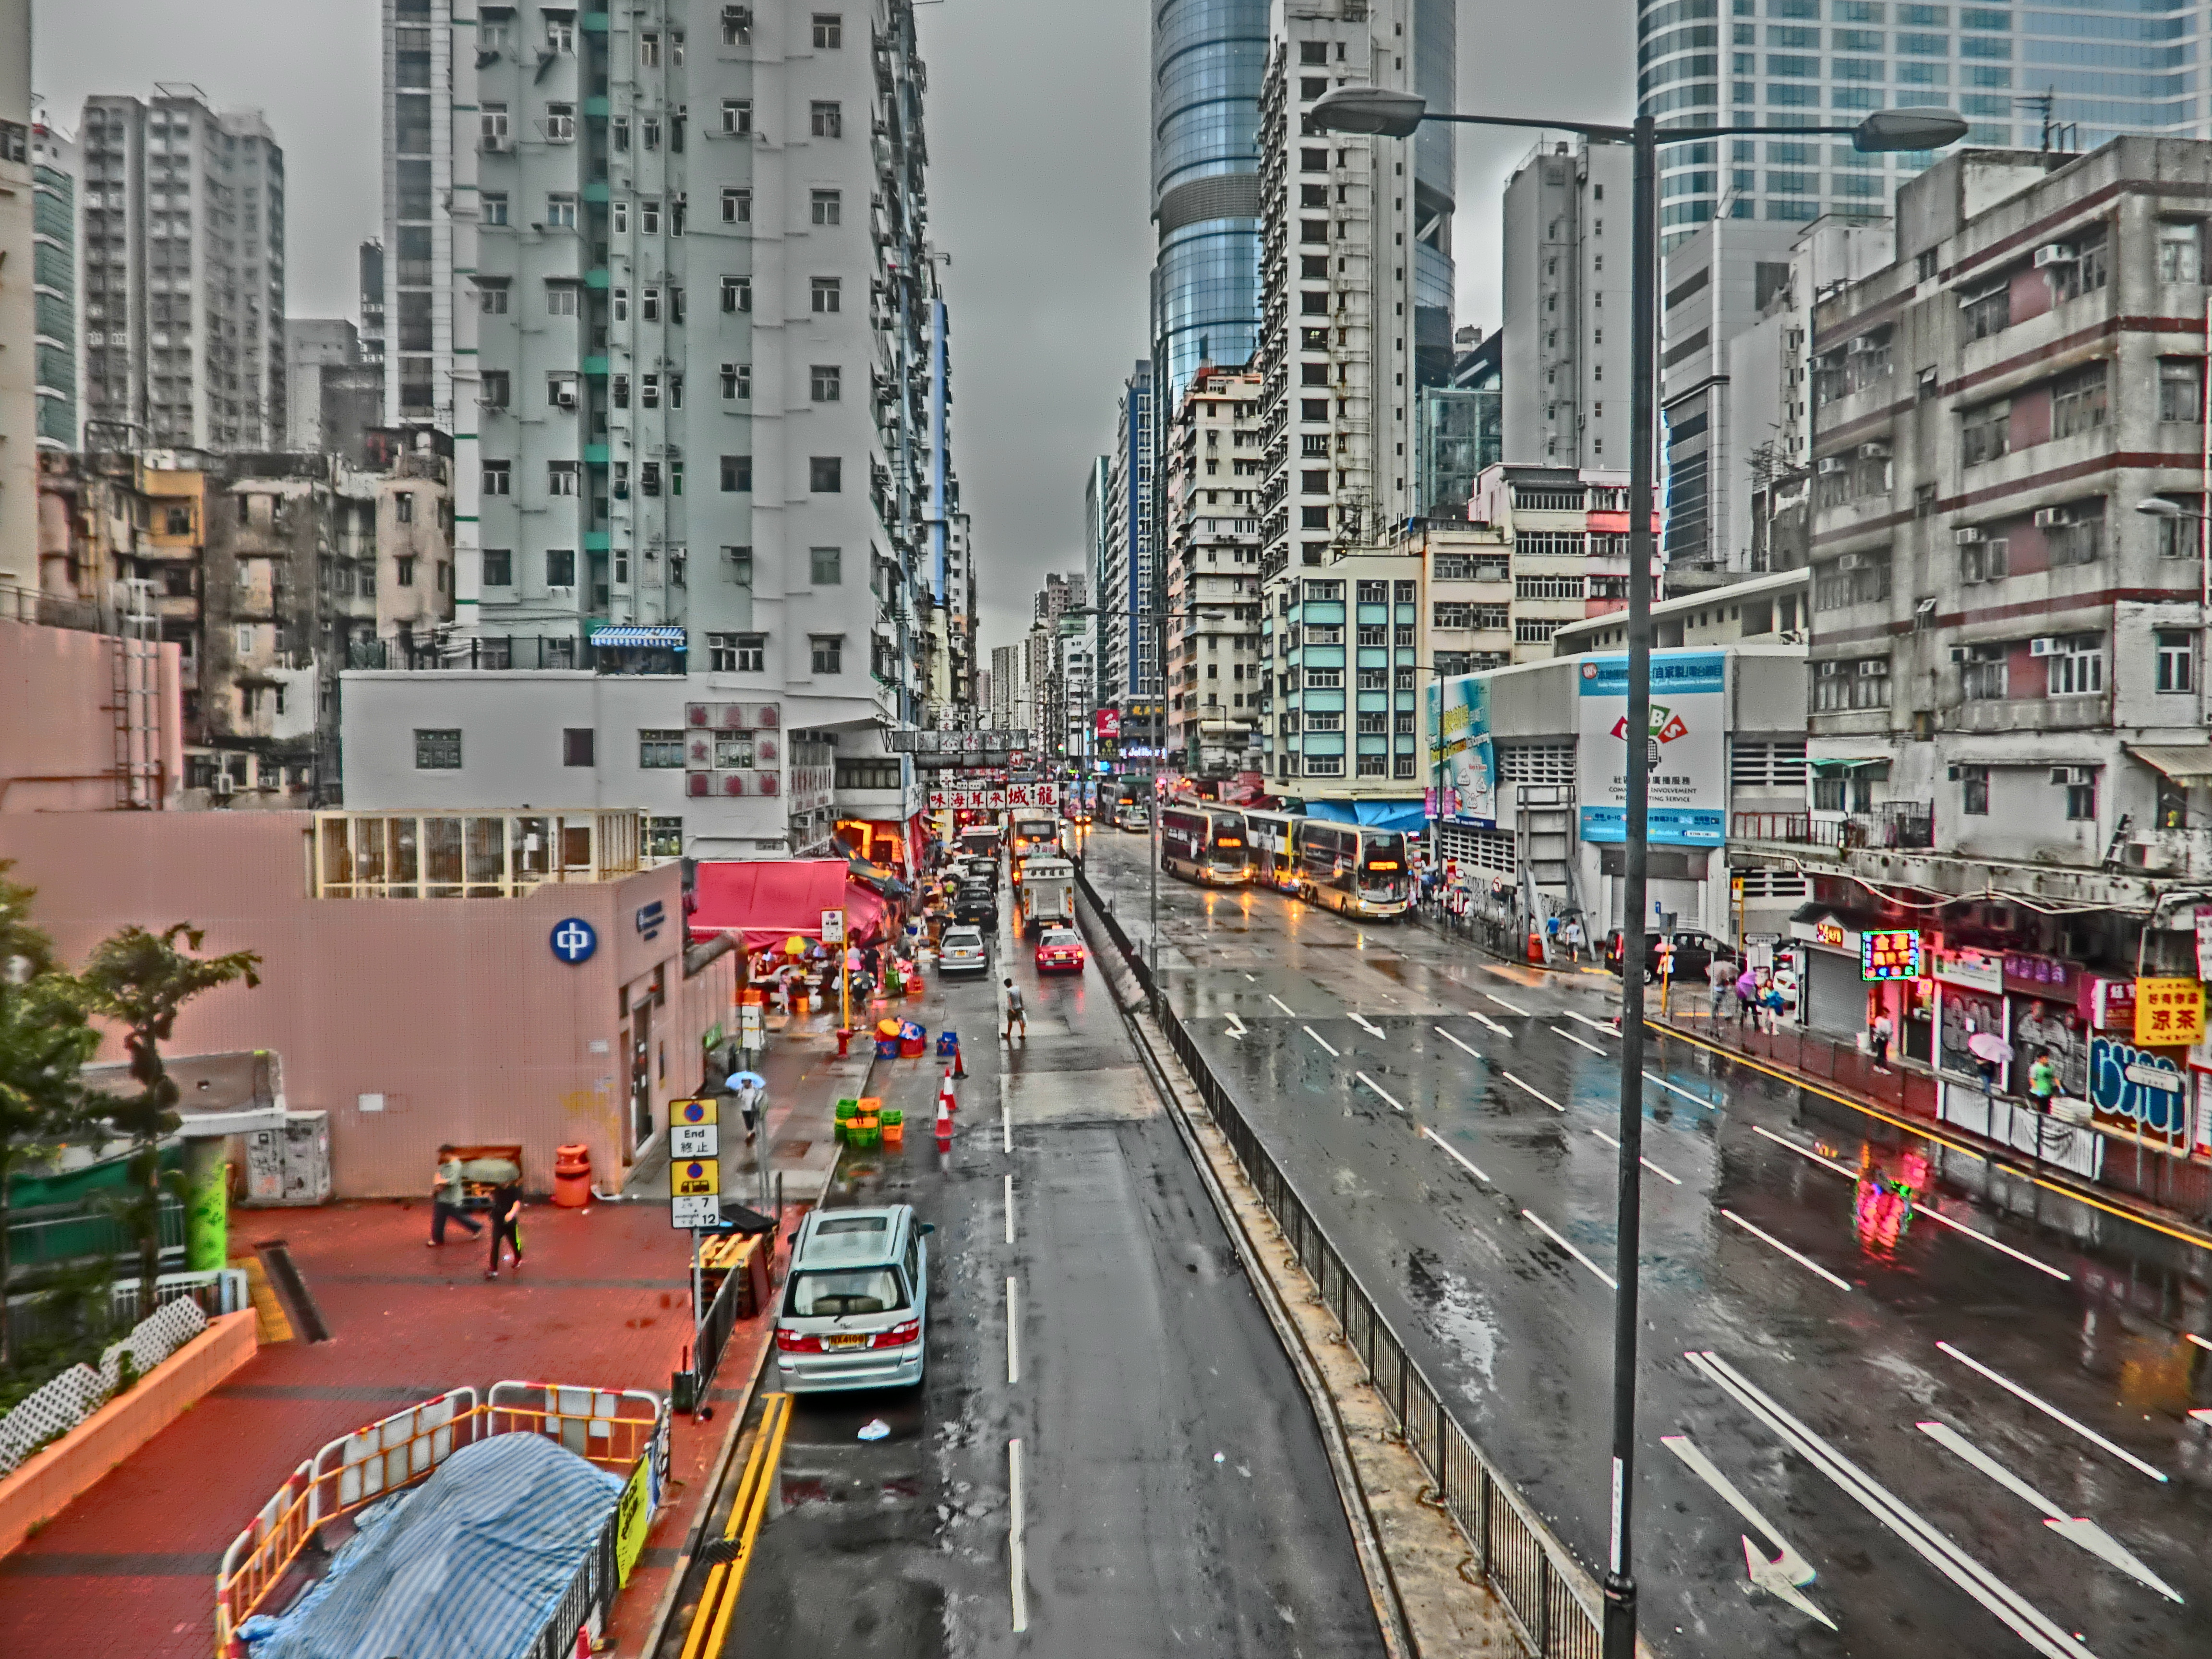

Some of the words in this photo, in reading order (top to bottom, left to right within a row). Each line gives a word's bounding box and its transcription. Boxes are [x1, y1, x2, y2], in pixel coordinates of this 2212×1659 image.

[2152, 1010, 2196, 1030] 涼茶
[685, 1130, 705, 1138] End
[680, 1142, 709, 1154] 終止
[702, 1197, 709, 1208] 7
[702, 1214, 716, 1225] 12
